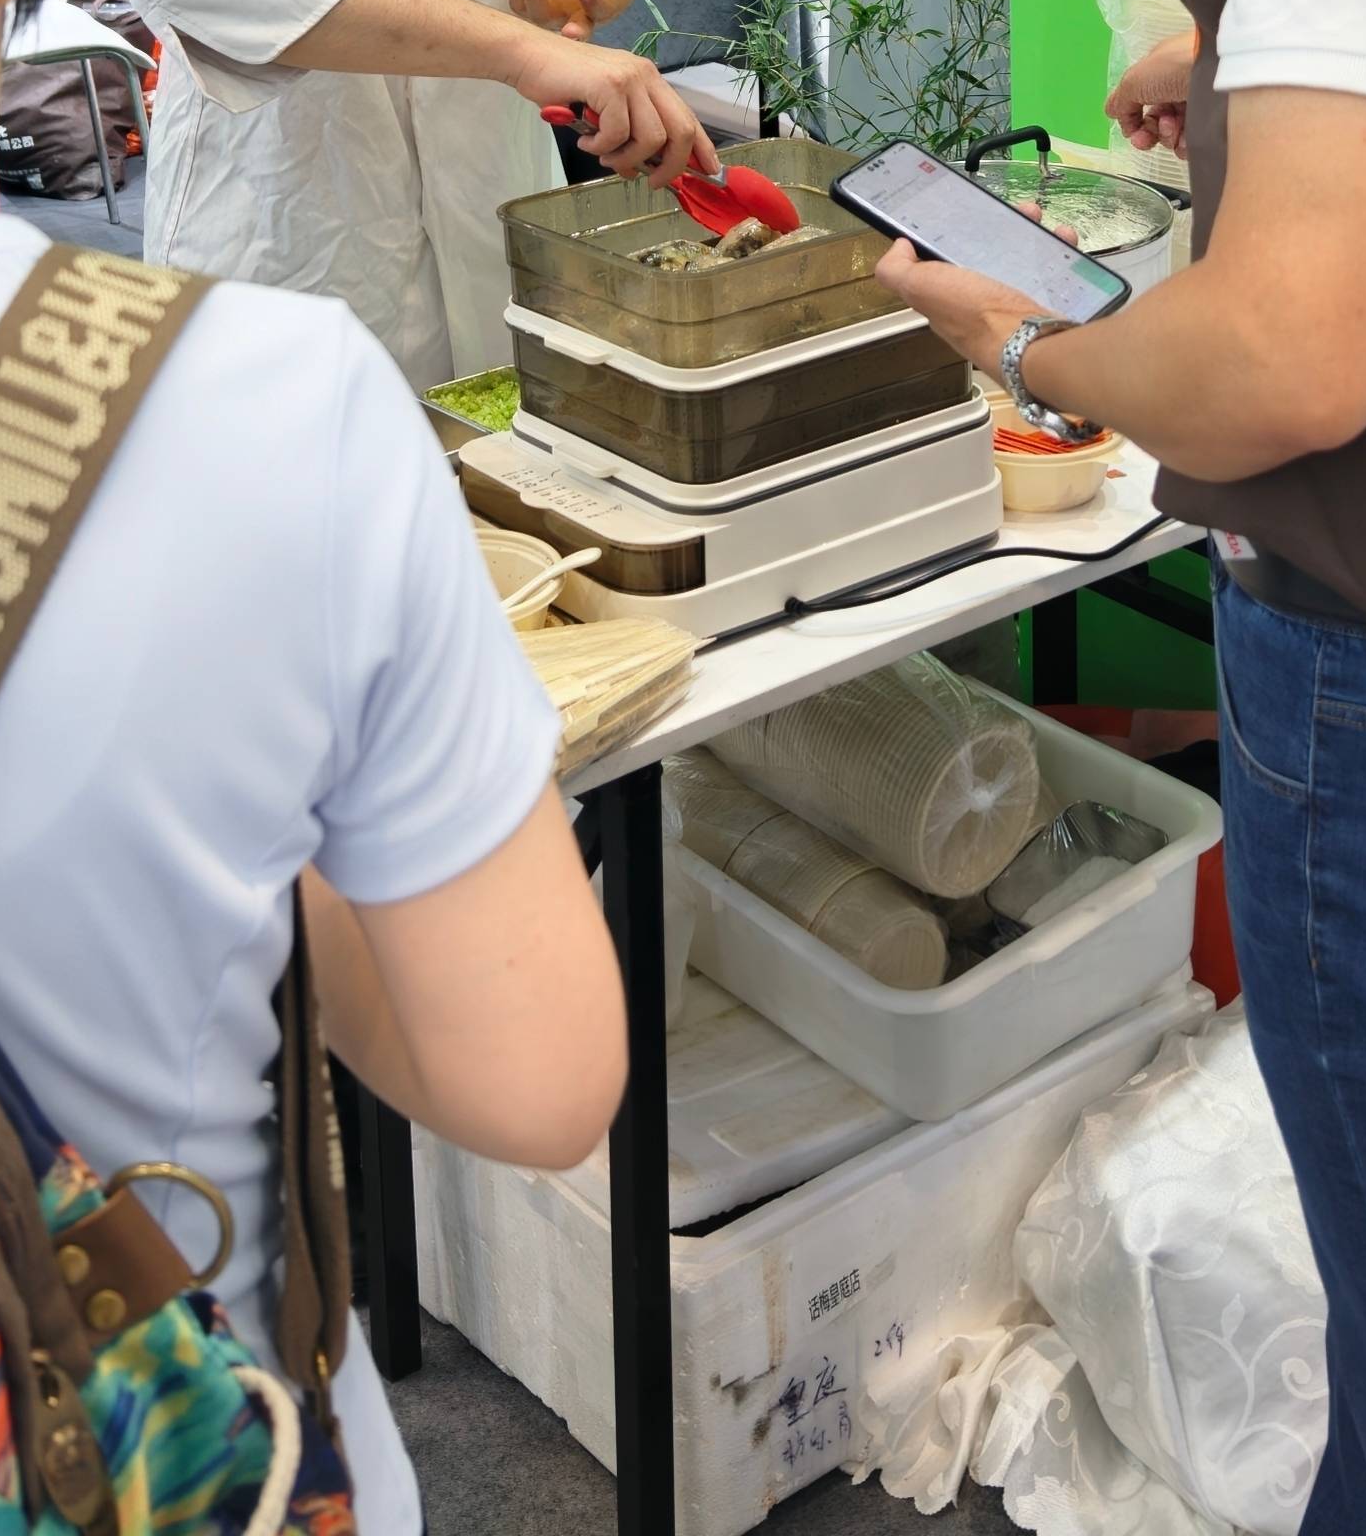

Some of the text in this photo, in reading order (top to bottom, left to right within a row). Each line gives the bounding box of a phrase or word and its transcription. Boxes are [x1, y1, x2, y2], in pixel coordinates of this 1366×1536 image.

[808, 1268, 861, 1322] 话梅皇庭店
